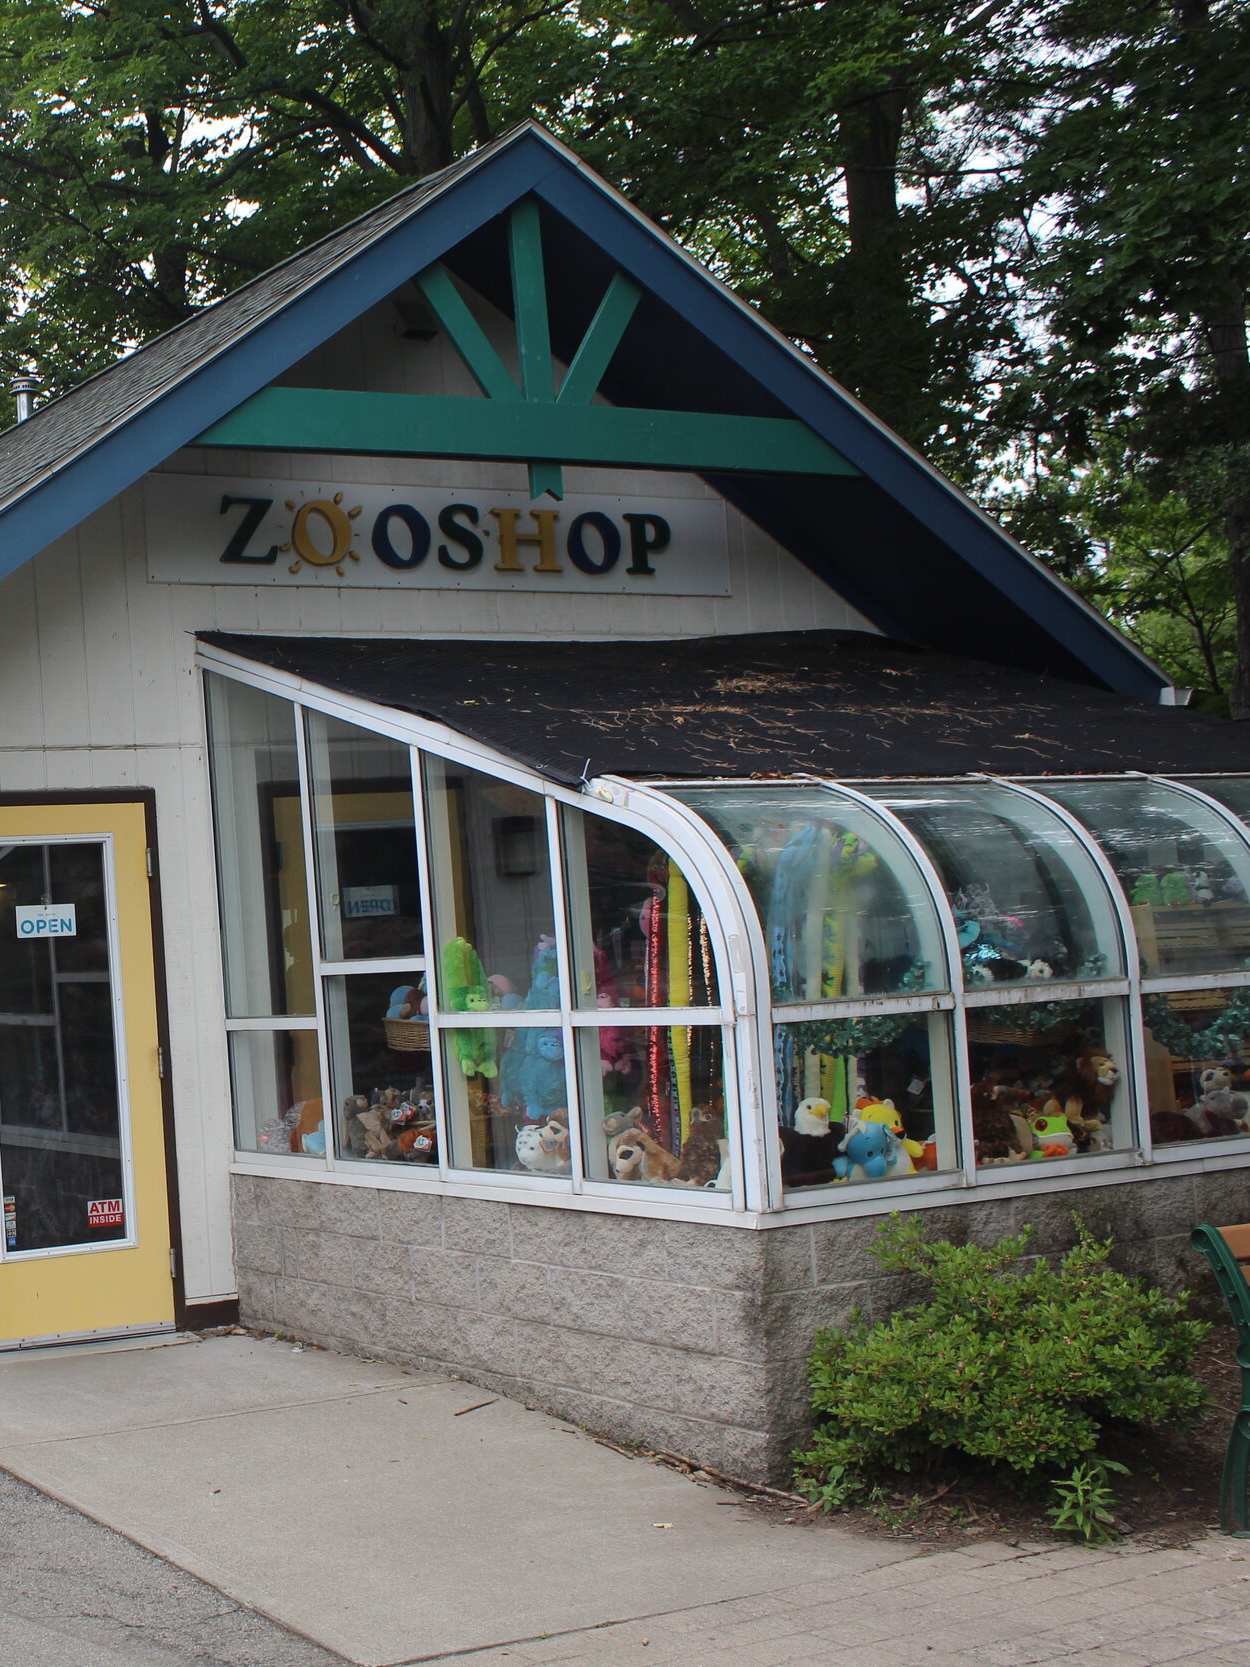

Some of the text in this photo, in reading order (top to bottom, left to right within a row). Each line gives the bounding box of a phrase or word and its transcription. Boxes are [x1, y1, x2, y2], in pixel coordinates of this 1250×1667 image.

[219, 494, 672, 576] ZOOSHOP
[21, 919, 72, 934] OPEN
[89, 1200, 120, 1214] ATM
[89, 1215, 121, 1224] INSIDE
